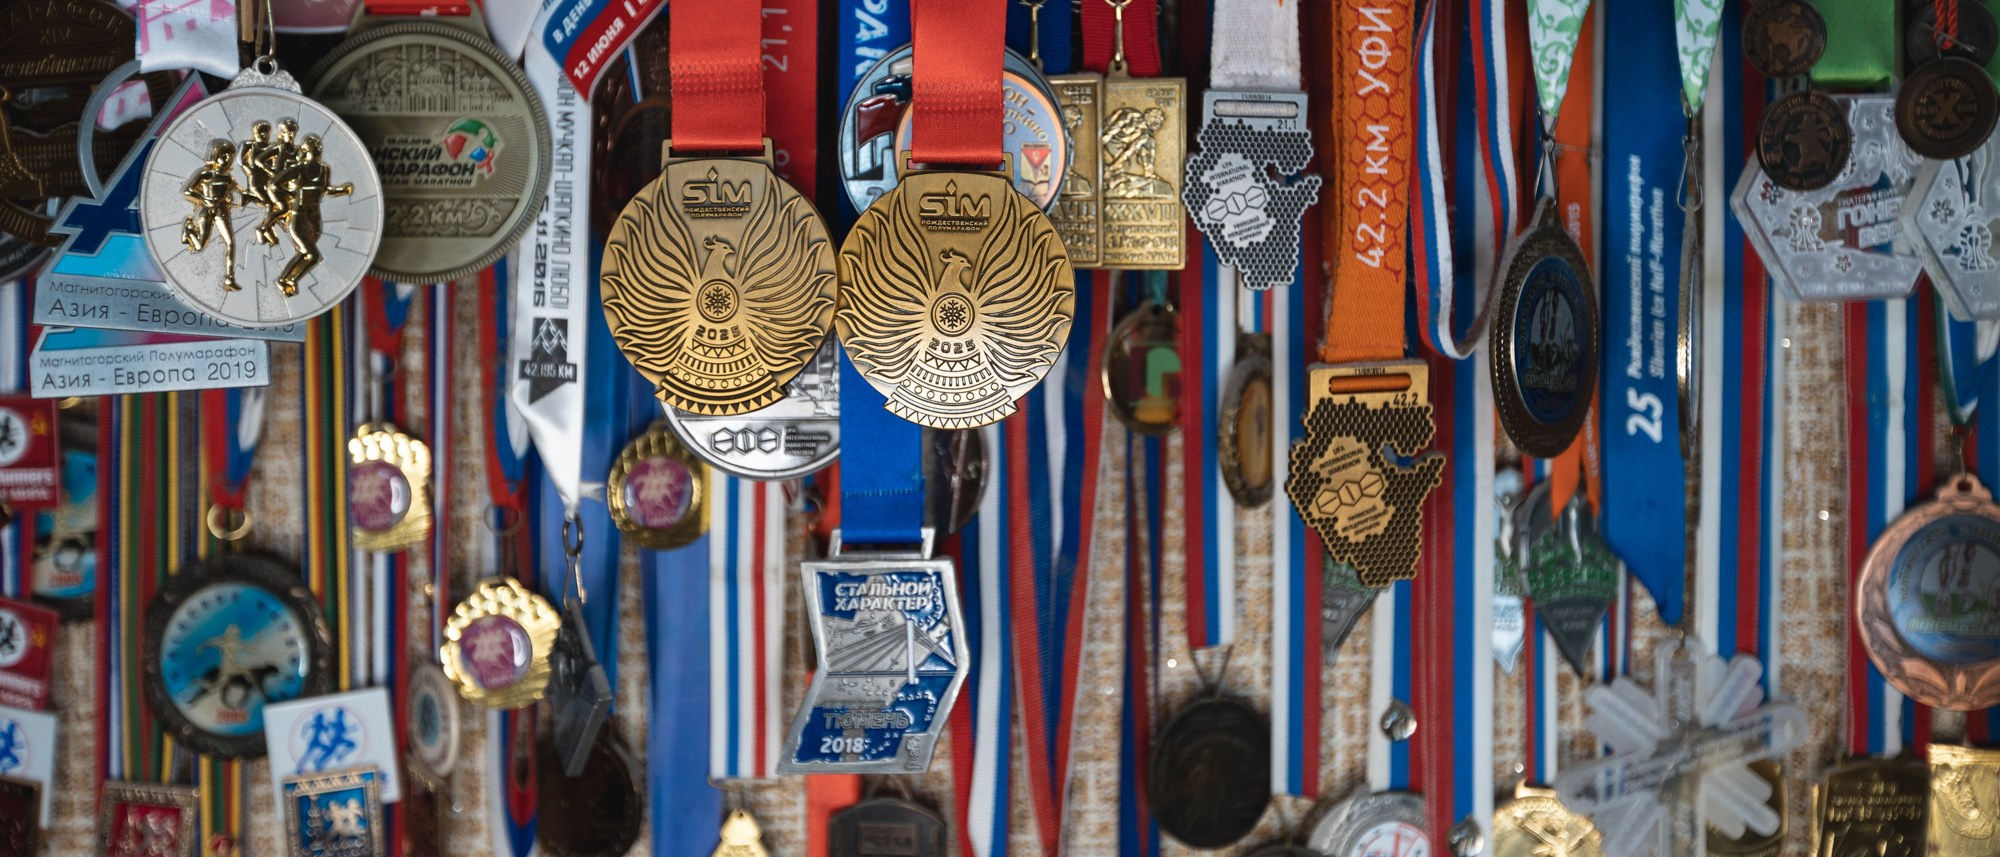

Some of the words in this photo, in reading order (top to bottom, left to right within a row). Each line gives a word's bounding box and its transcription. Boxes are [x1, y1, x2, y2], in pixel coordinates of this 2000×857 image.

[552, 29, 563, 44] В
[573, 60, 589, 79] 12
[587, 17, 625, 64] ИЮНЯ
[1003, 86, 1029, 108] ОН
[1006, 108, 1048, 141] ПКИНО
[1277, 119, 1297, 131] 21,1
[369, 145, 442, 161] НСКИЙ
[377, 163, 476, 176] МАРАФОН
[1837, 196, 1905, 231] ГОНЕ
[1357, 189, 1387, 268] 42.2
[1858, 222, 1905, 250] ВЕС
[50, 280, 175, 300] Магнитогорский
[48, 298, 109, 320] Азия
[699, 325, 740, 341] 2025
[928, 337, 976, 354] 2025
[40, 351, 144, 369] Магнитогорский
[149, 345, 256, 364] Полумарафон
[41, 372, 91, 390] Азия
[114, 367, 195, 387] Европа
[207, 360, 256, 381] 2019
[1393, 392, 1419, 407] 42,2
[1627, 386, 1663, 443] 25
[834, 578, 931, 597] СТАЛЬНОЙ
[834, 597, 928, 611] ХАРАКТЕР
[823, 712, 909, 730] ТЮМЕНЬ
[820, 737, 864, 754] 2018
